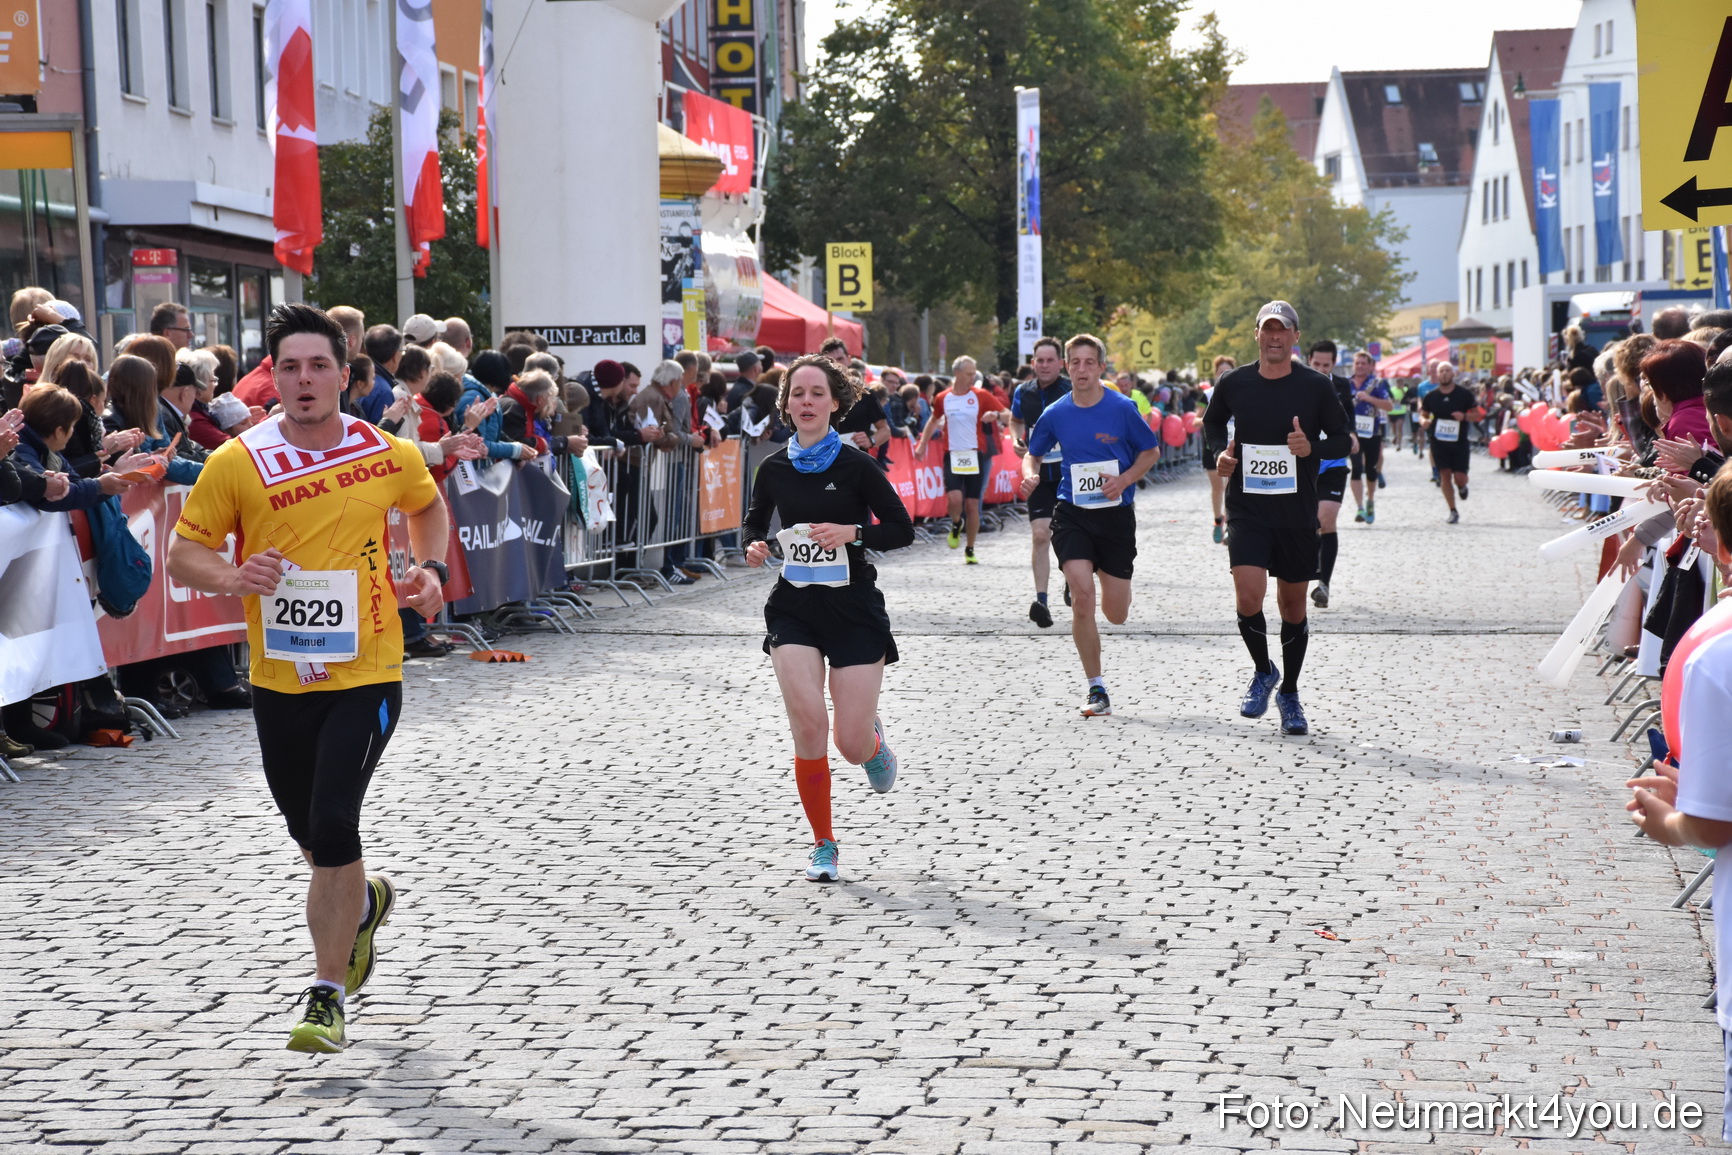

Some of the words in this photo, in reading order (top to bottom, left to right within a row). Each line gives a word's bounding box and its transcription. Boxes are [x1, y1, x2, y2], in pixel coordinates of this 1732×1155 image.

[832, 246, 867, 258] Block
[839, 264, 861, 296] B
[534, 328, 640, 344] MINI-Partl.de
[1140, 340, 1152, 358] C
[1483, 351, 1492, 364] D
[1202, 359, 1212, 372] D
[957, 458, 972, 466] 295
[1250, 460, 1288, 475] 2286
[269, 478, 331, 511] MAX
[335, 459, 402, 488] BÖGL
[1079, 477, 1107, 491] 204
[790, 543, 837, 563] 2929
[275, 598, 343, 627] 2629
[290, 636, 326, 647] Manuel
